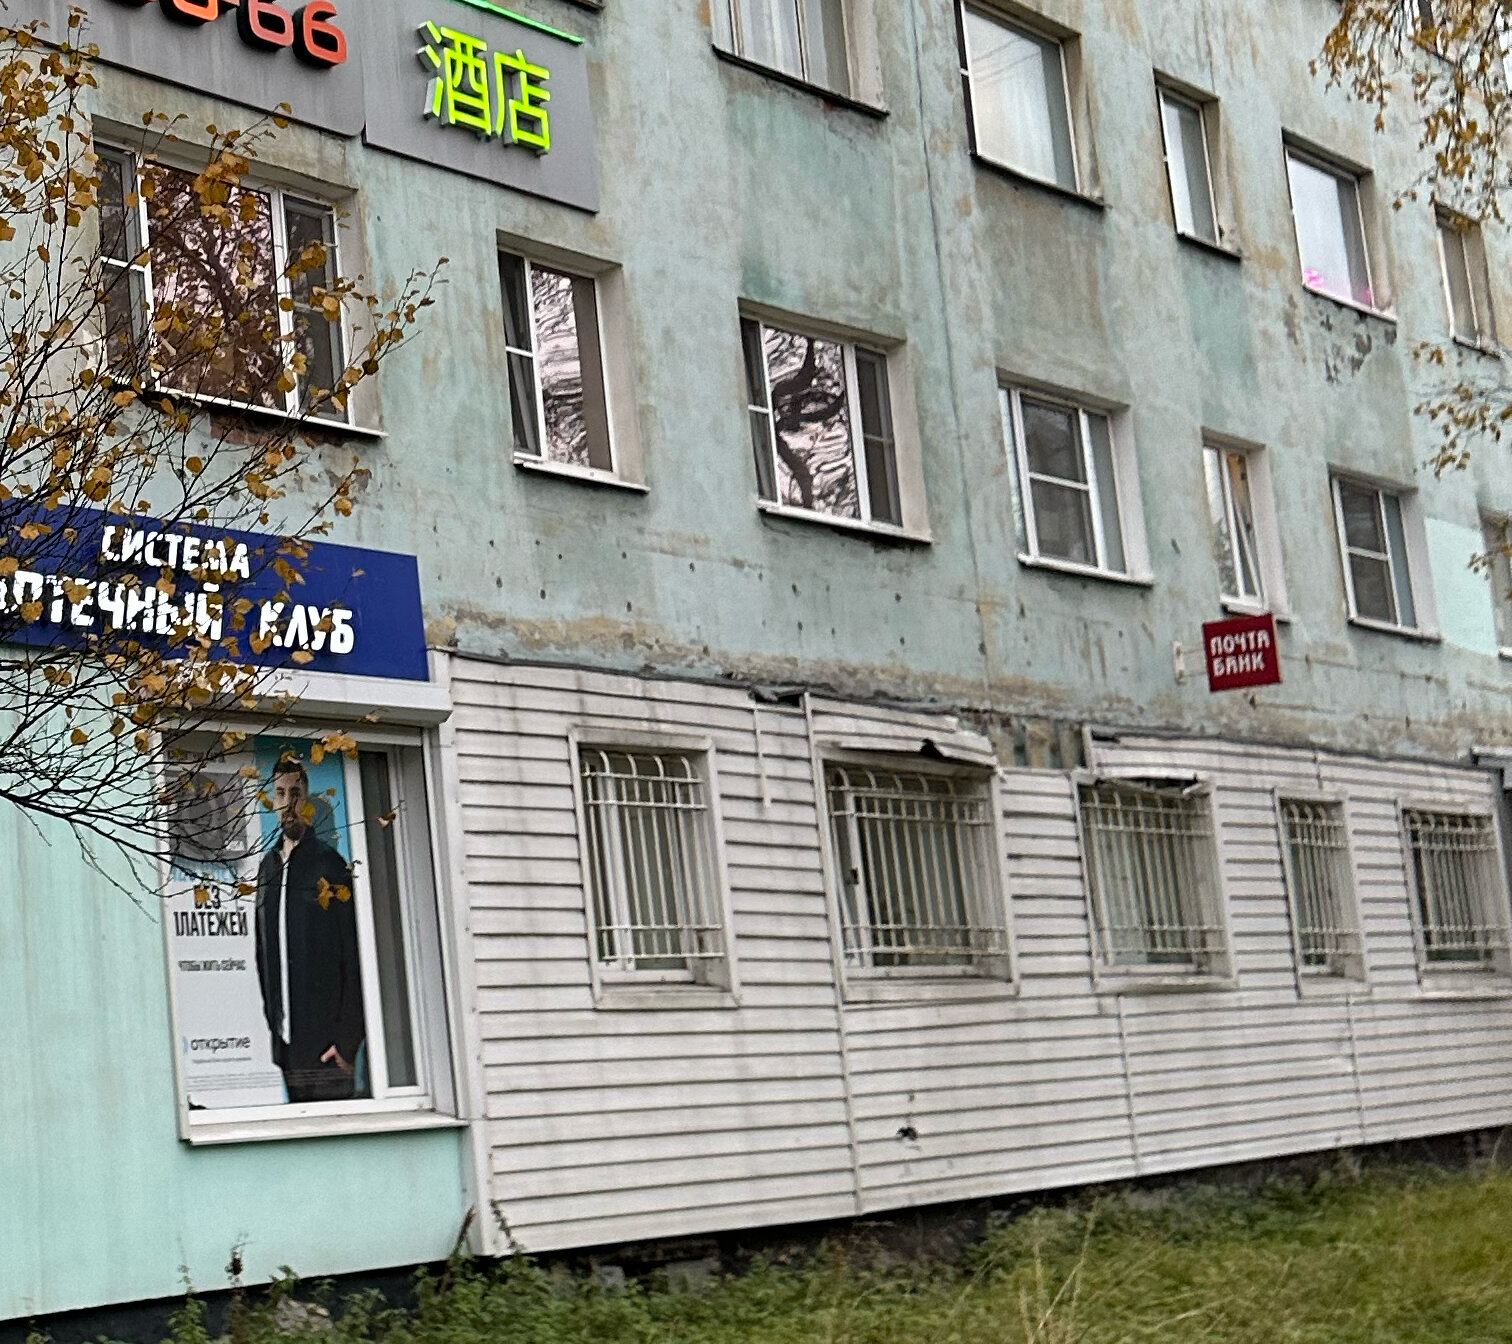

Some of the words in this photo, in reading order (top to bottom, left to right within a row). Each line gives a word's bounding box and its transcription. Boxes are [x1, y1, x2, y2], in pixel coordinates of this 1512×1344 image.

[416, 20, 551, 156] 酒店
[259, 600, 355, 654] КЛУБ
[1209, 629, 1270, 657] ПОЧТА
[1213, 651, 1265, 677] БАНК
